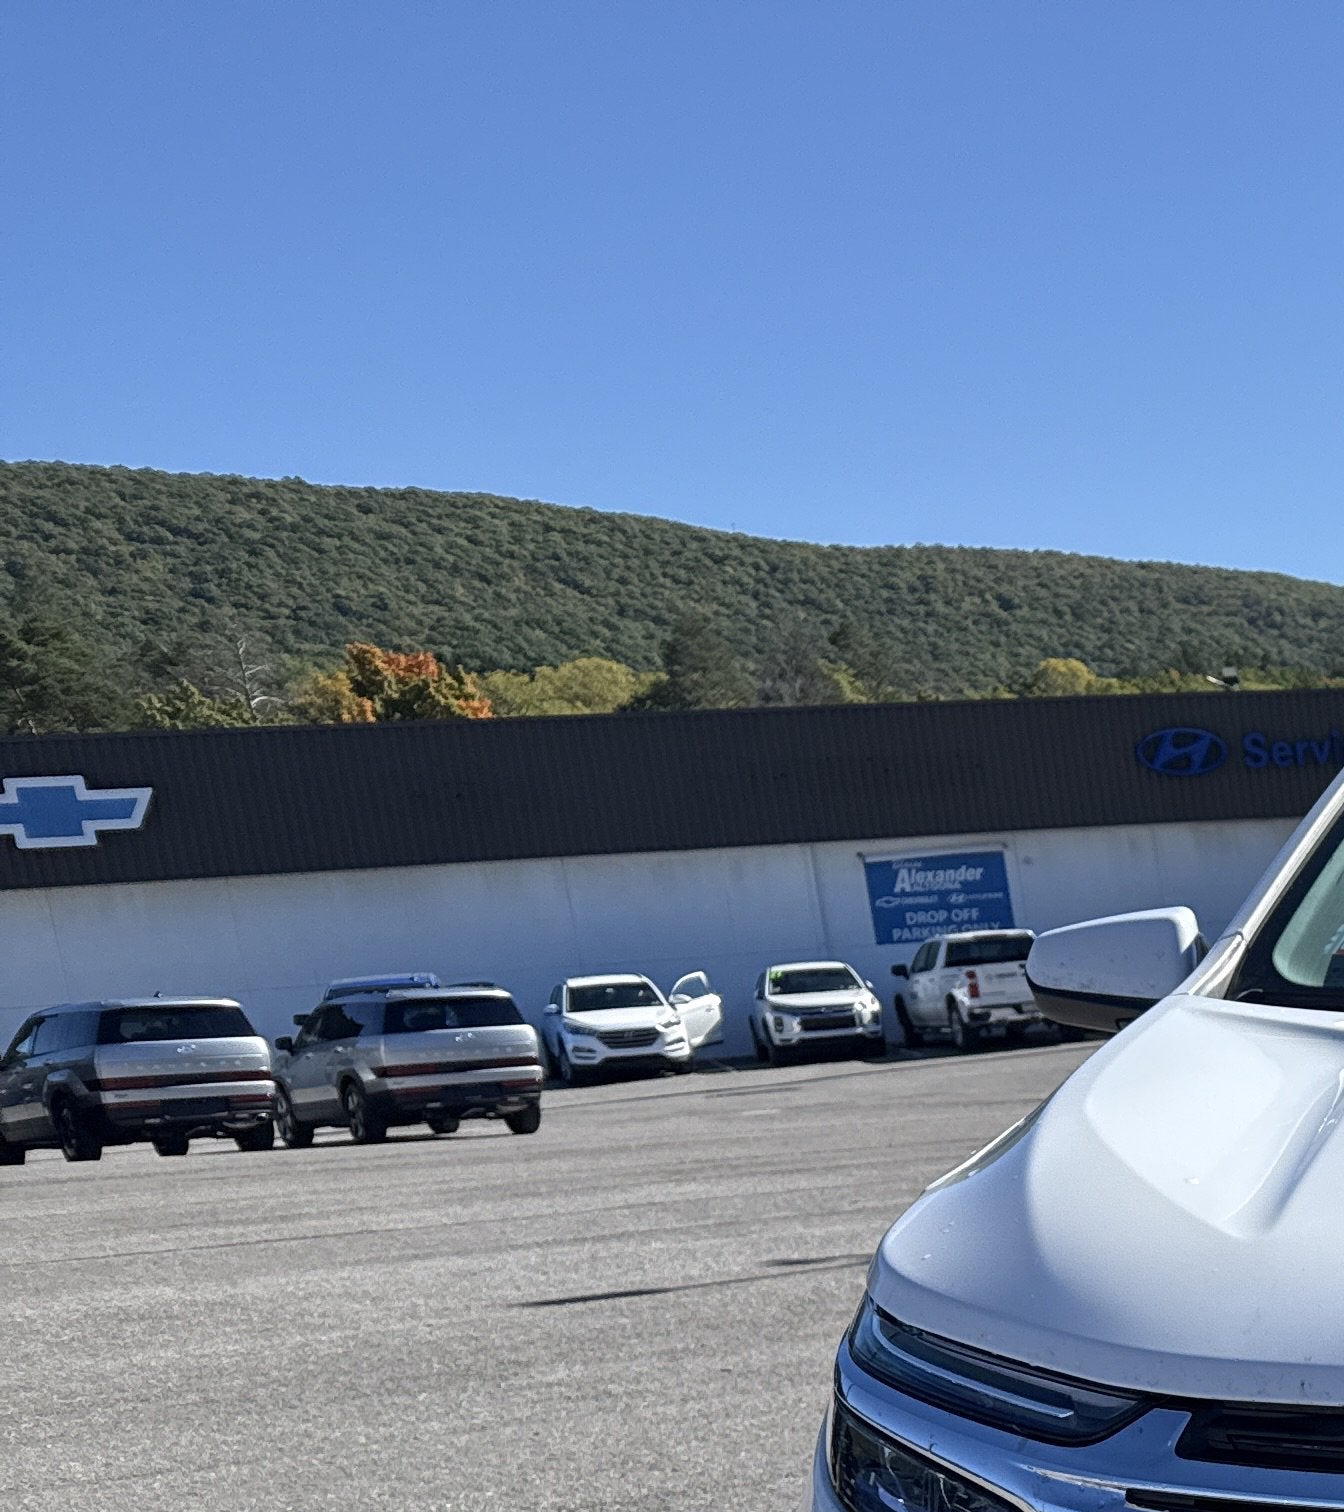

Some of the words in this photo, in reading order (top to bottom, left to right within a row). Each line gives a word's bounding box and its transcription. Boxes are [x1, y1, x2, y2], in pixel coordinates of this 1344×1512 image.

[893, 864, 984, 893] Alexander
[904, 910, 949, 926] DROP
[951, 907, 980, 922] OFF
[891, 924, 959, 942] PARKING
